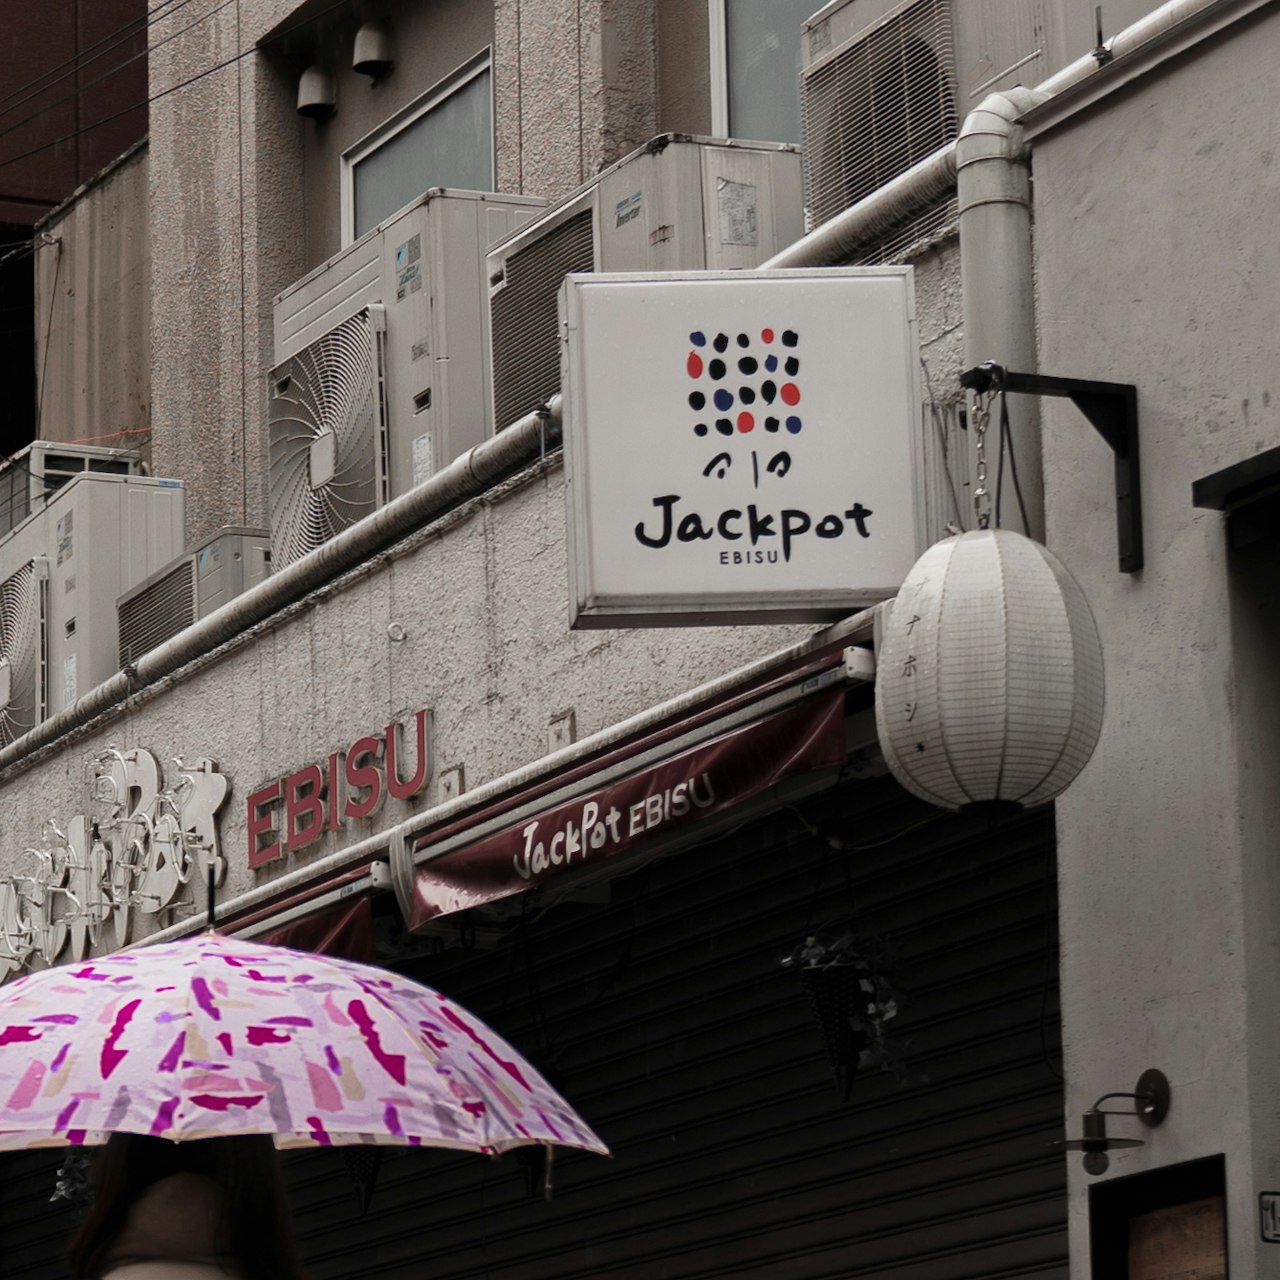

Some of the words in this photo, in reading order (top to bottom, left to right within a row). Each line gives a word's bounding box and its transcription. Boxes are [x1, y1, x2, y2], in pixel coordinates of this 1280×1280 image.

[635, 495, 873, 562] Jackpot
[719, 550, 779, 565] EBISU
[247, 709, 432, 871] EBISU
[628, 772, 717, 838] EBISU
